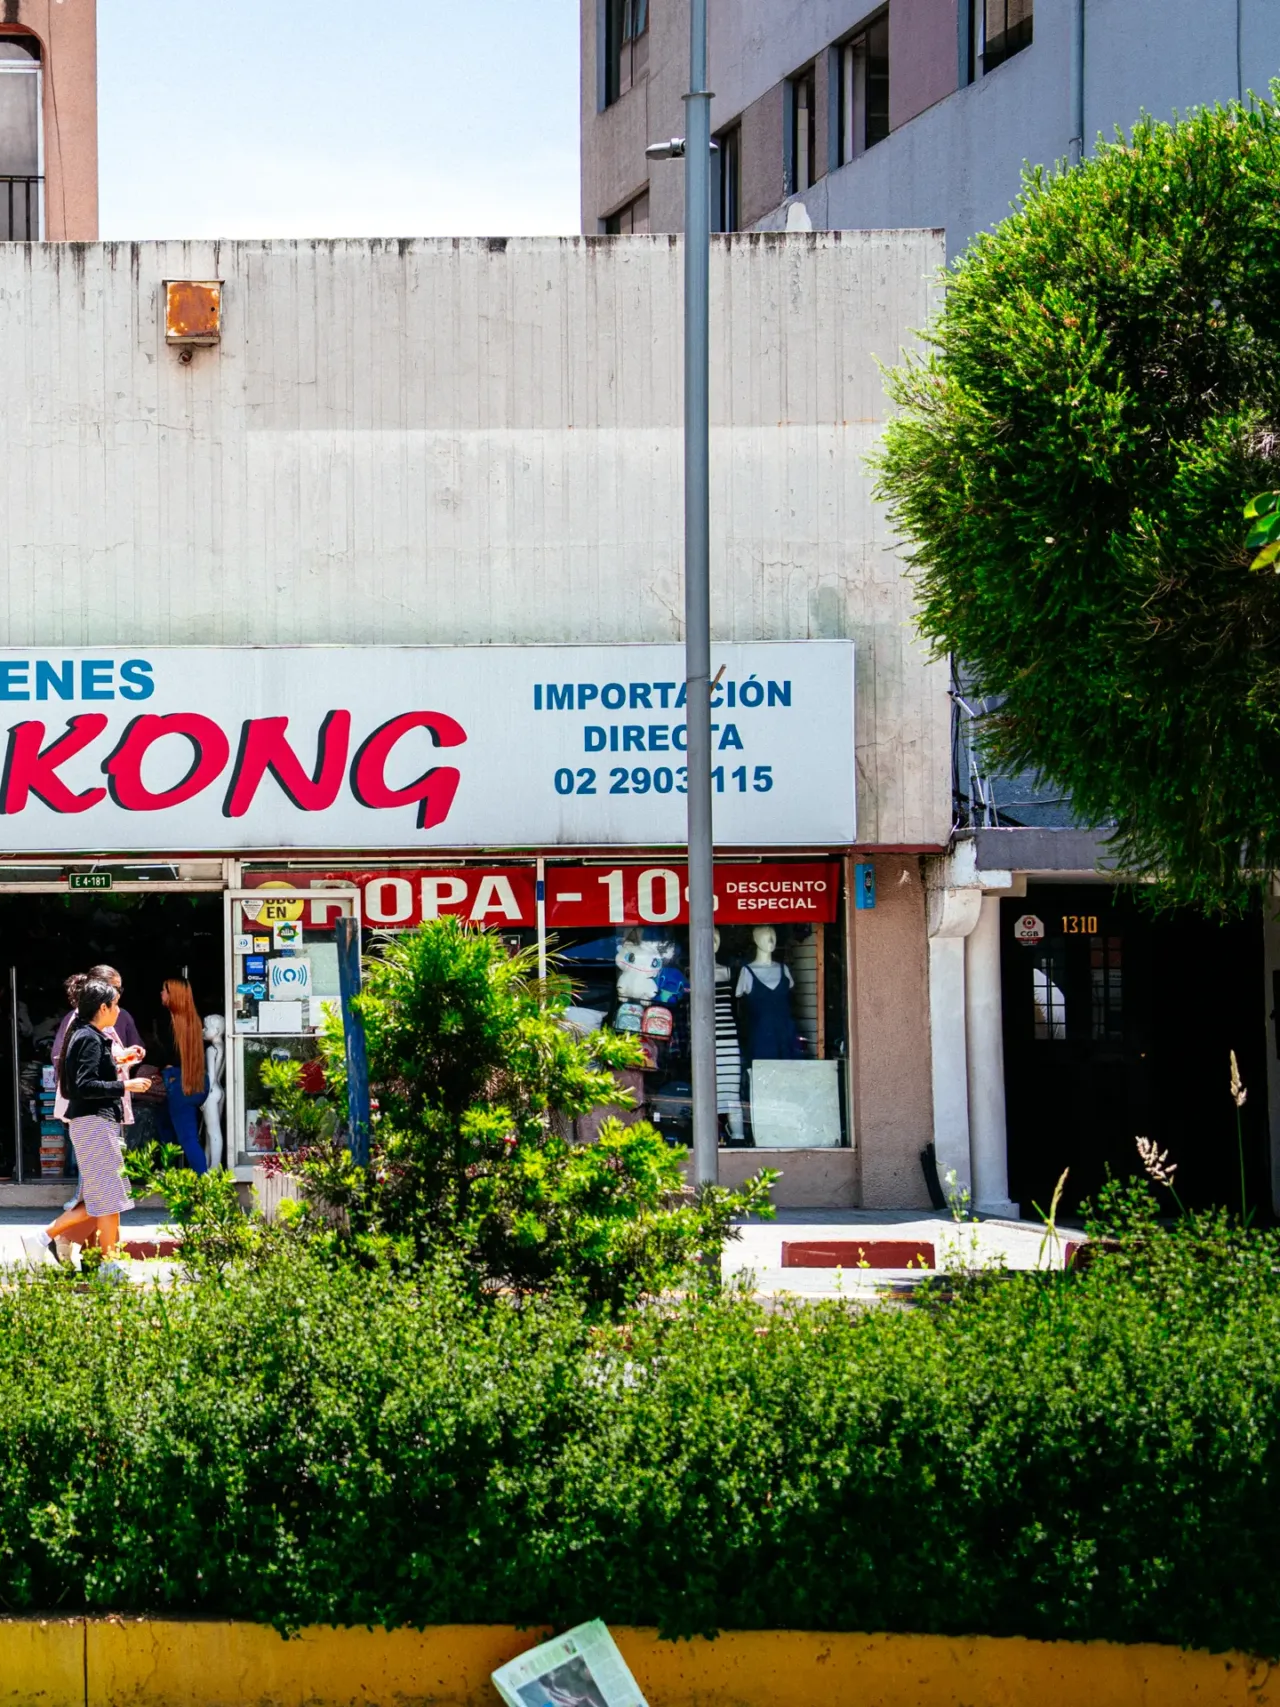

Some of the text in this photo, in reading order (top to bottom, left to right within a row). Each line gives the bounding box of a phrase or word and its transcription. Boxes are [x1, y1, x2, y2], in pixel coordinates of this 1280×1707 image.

[584, 724, 744, 752] DIRECA
[554, 767, 597, 794] 02
[75, 876, 106, 887] E 4-181
[726, 880, 827, 893] DESCUENTO
[737, 897, 817, 910] ESPECIAL
[267, 906, 287, 919] EN
[1061, 916, 1098, 934] 1310
